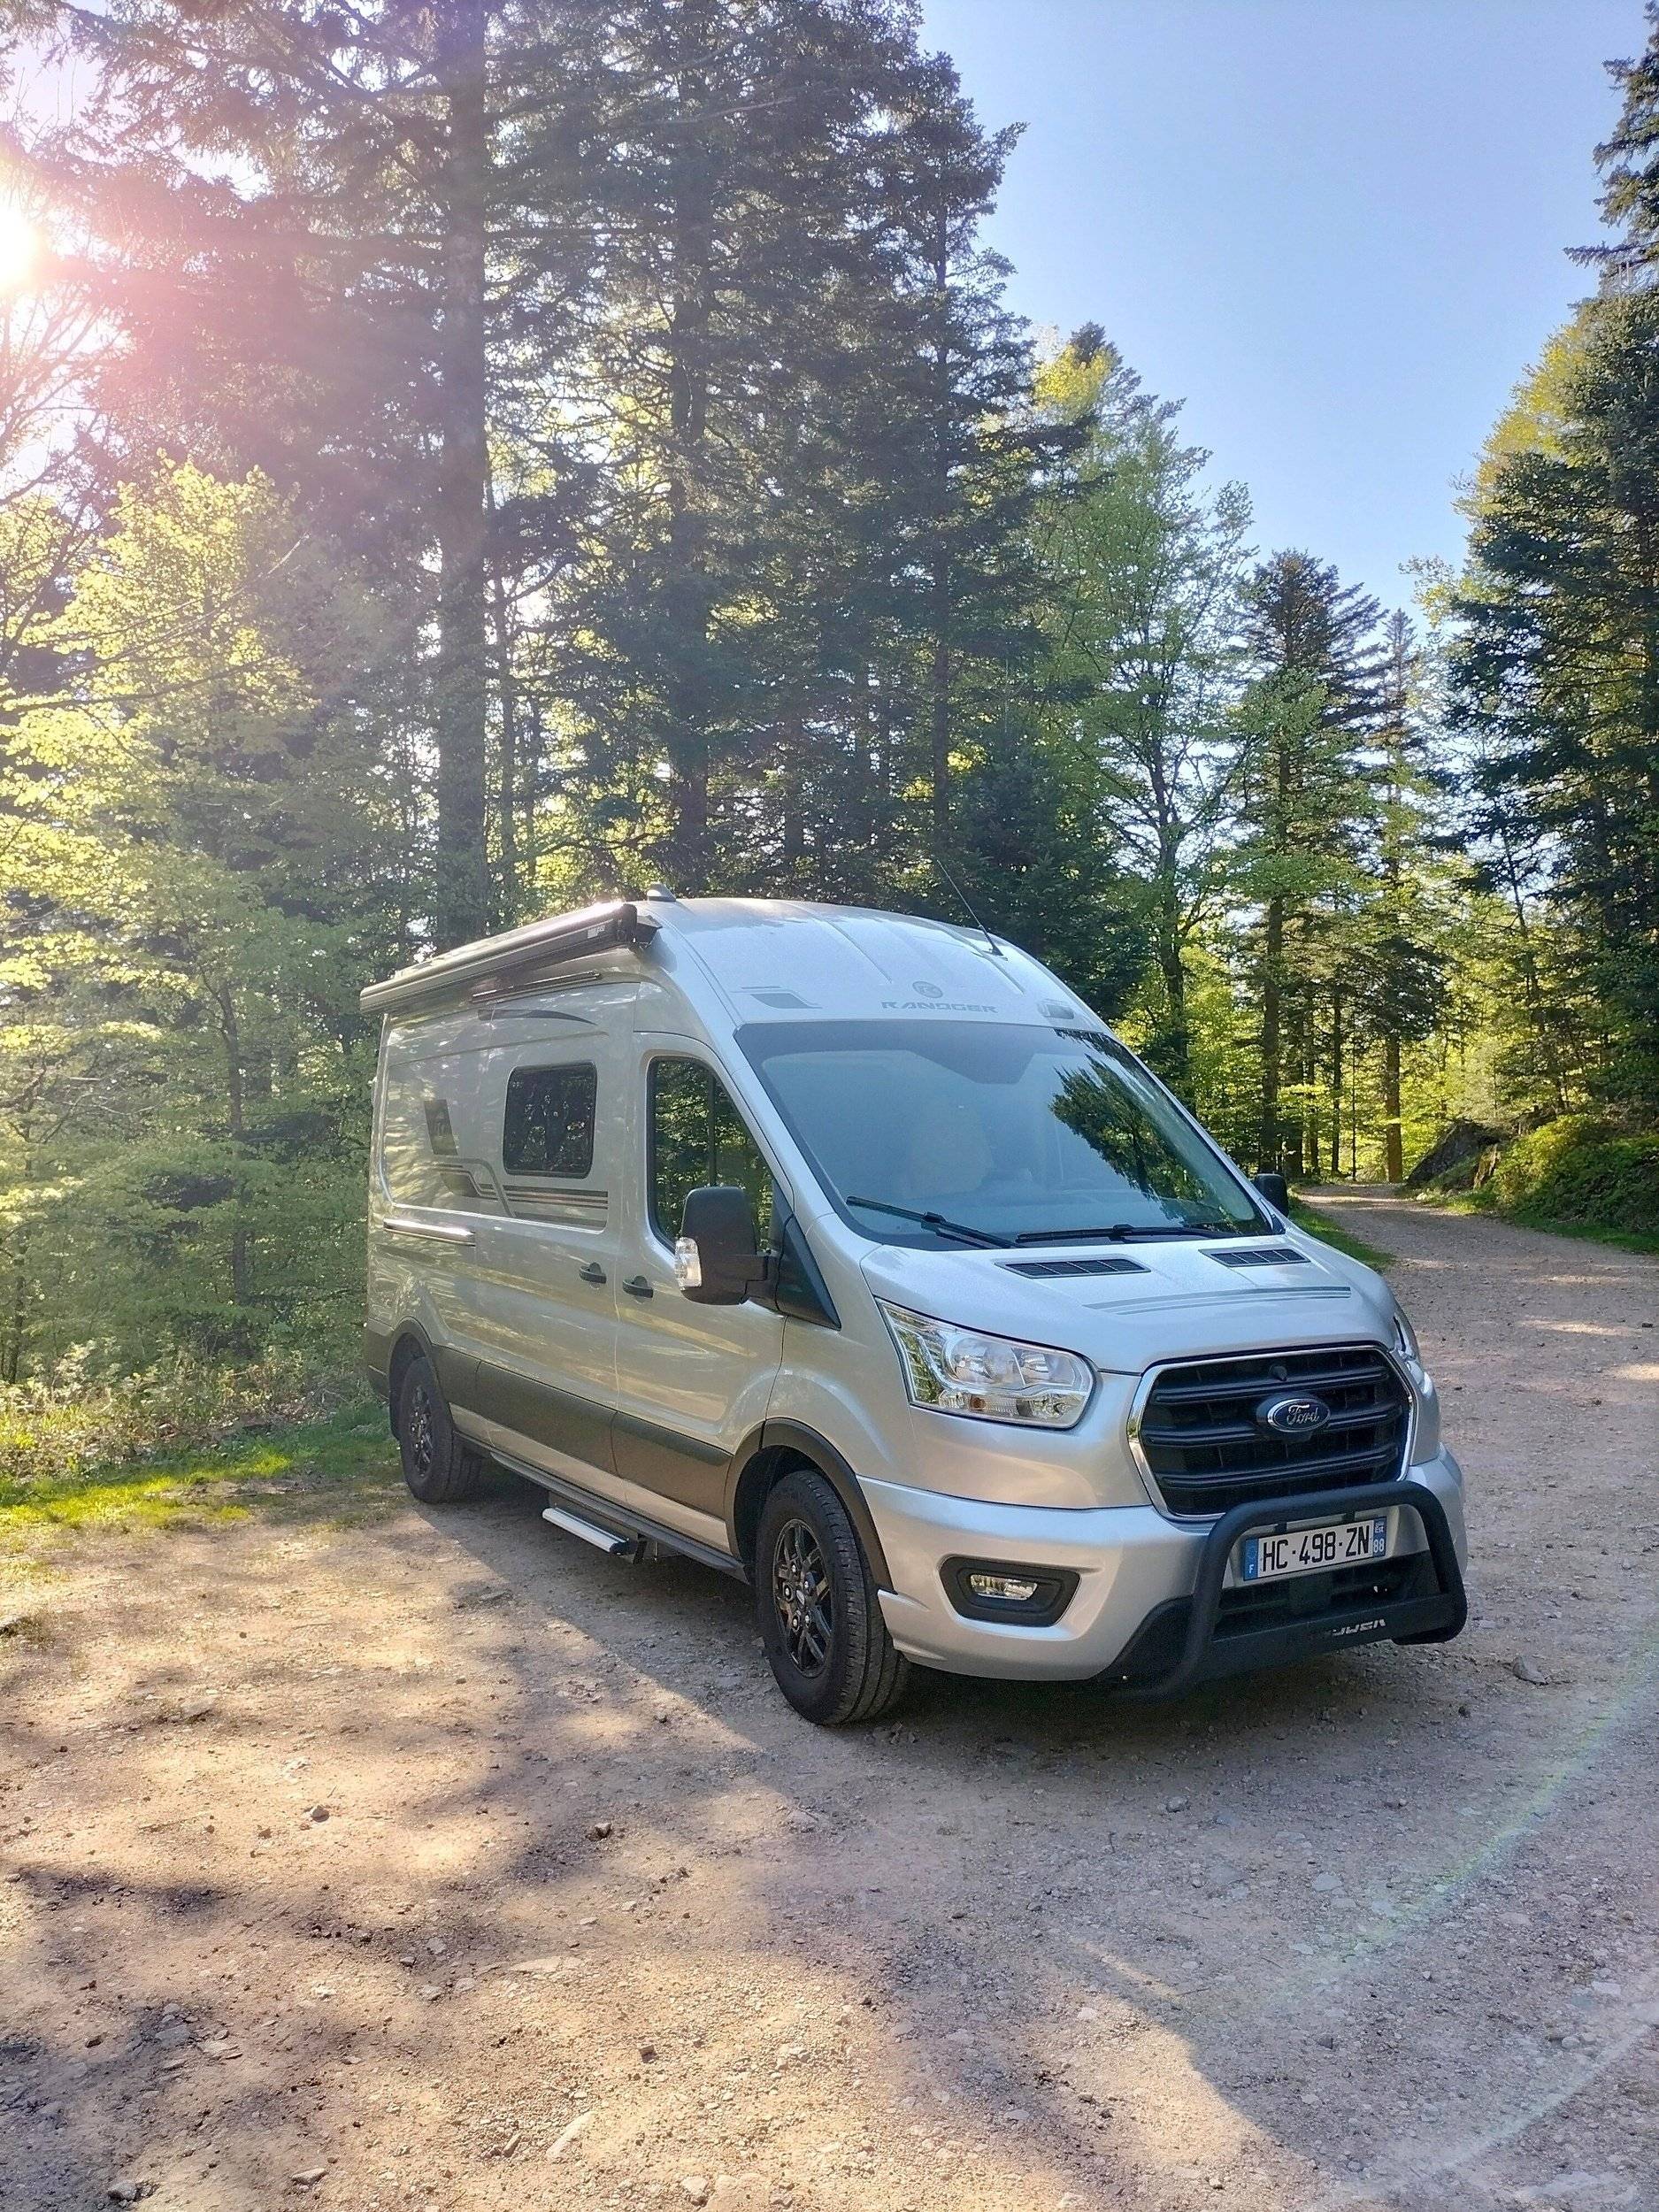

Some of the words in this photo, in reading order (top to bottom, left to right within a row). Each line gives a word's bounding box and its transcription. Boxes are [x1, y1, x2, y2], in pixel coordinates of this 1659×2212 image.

[1286, 1404, 1320, 1425] Ford
[1373, 1538, 1385, 1554] 88
[1248, 1563, 1255, 1574] F
